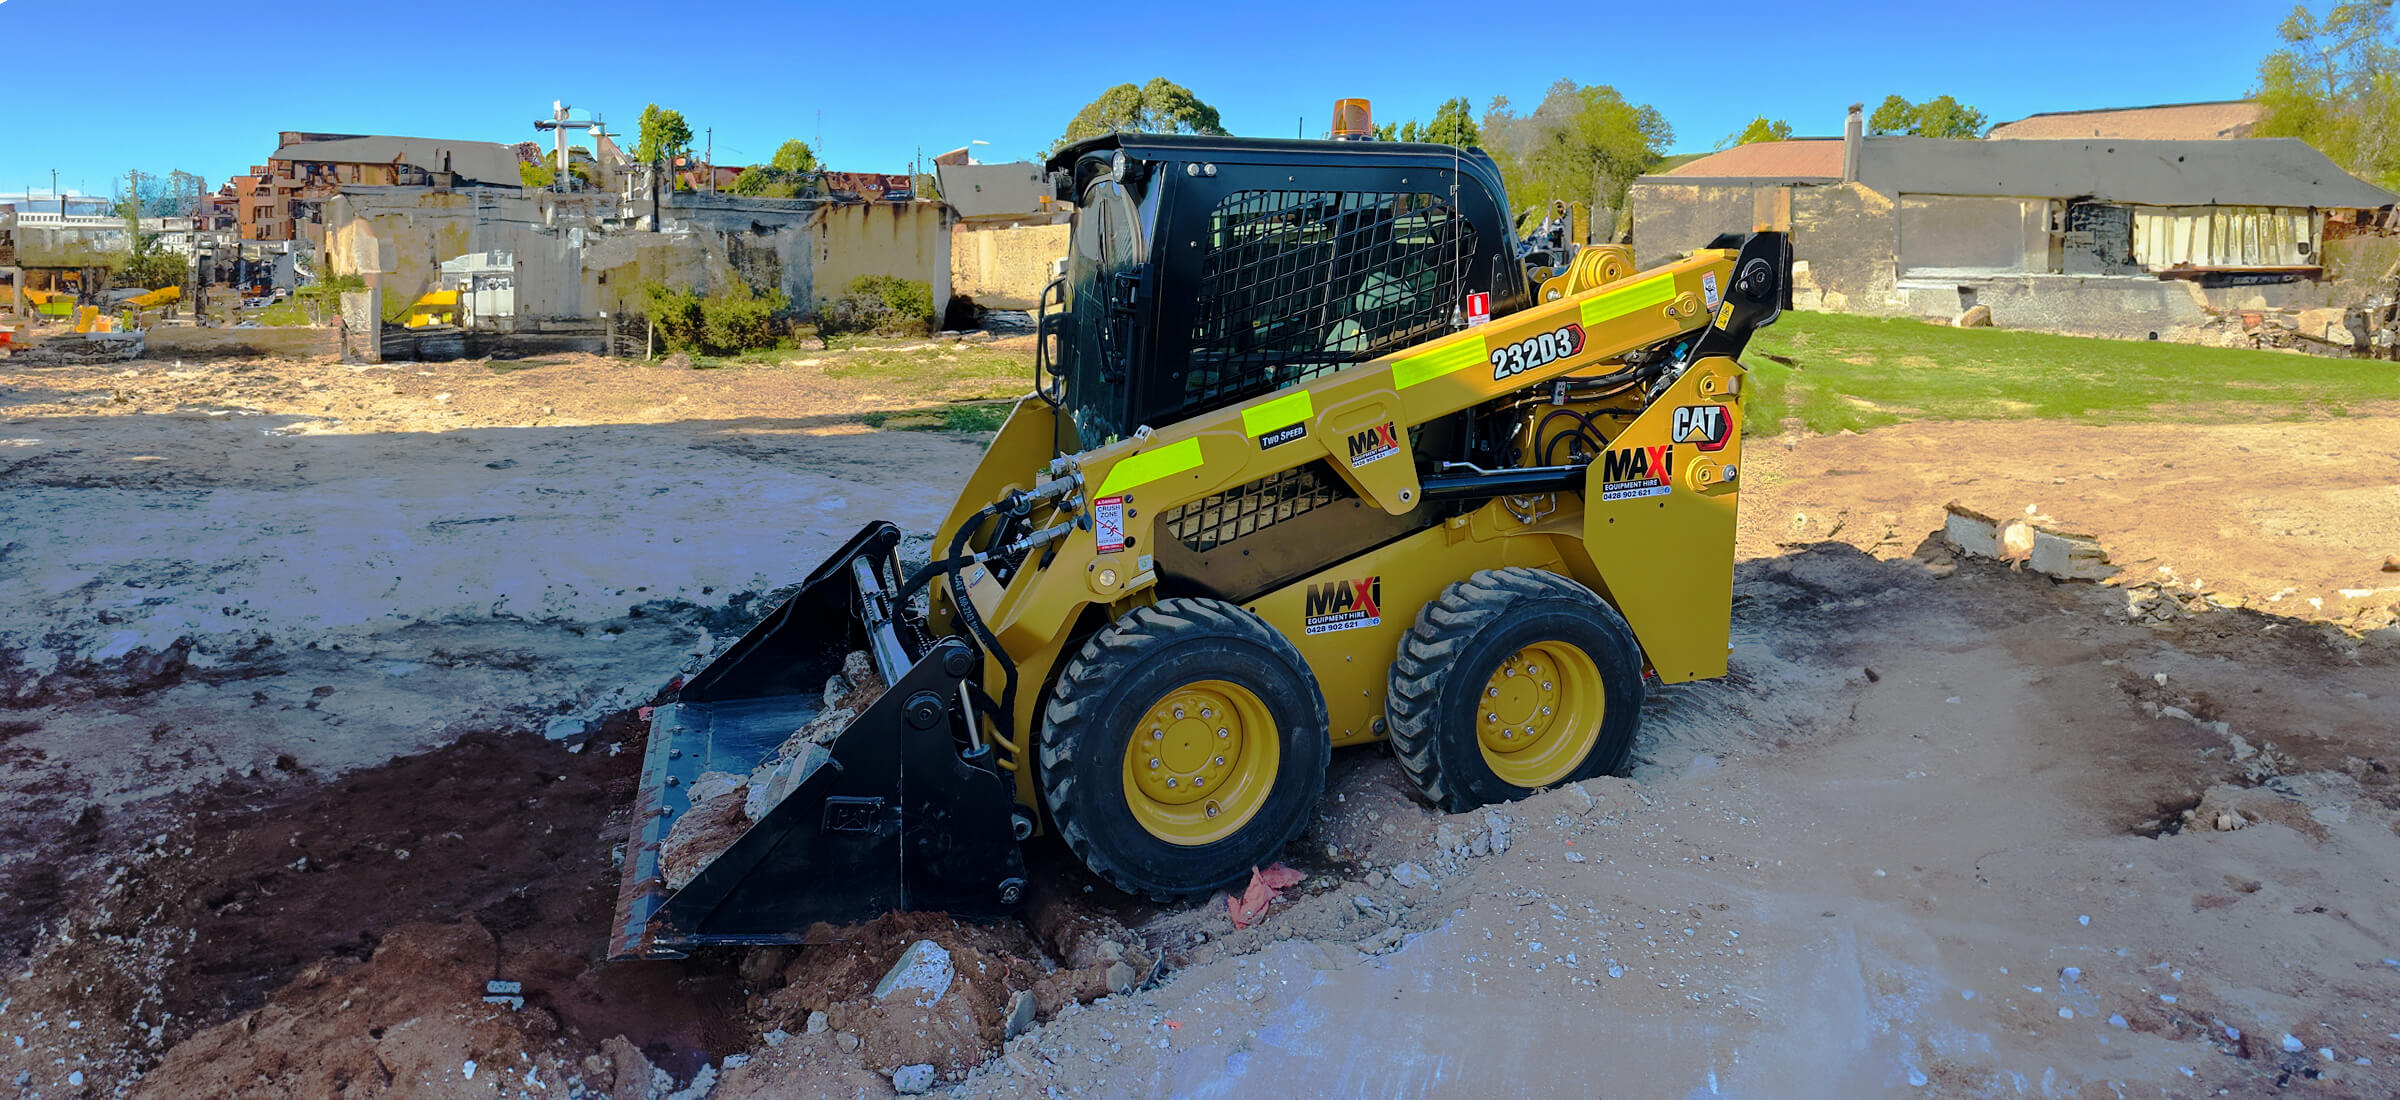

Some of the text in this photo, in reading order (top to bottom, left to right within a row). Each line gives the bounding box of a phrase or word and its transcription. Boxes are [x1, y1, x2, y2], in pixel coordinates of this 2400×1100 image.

[1491, 328, 1573, 380] 232D3
[1673, 406, 1721, 443] CAT
[1604, 479, 1658, 491] EQUIPMENT HIRE
[1603, 489, 1651, 500] 0428 902 621
[1097, 504, 1121, 512] CRUSH
[1307, 611, 1365, 625] EQUIPMENT HIRE
[1306, 621, 1358, 634] 0428 902 621
